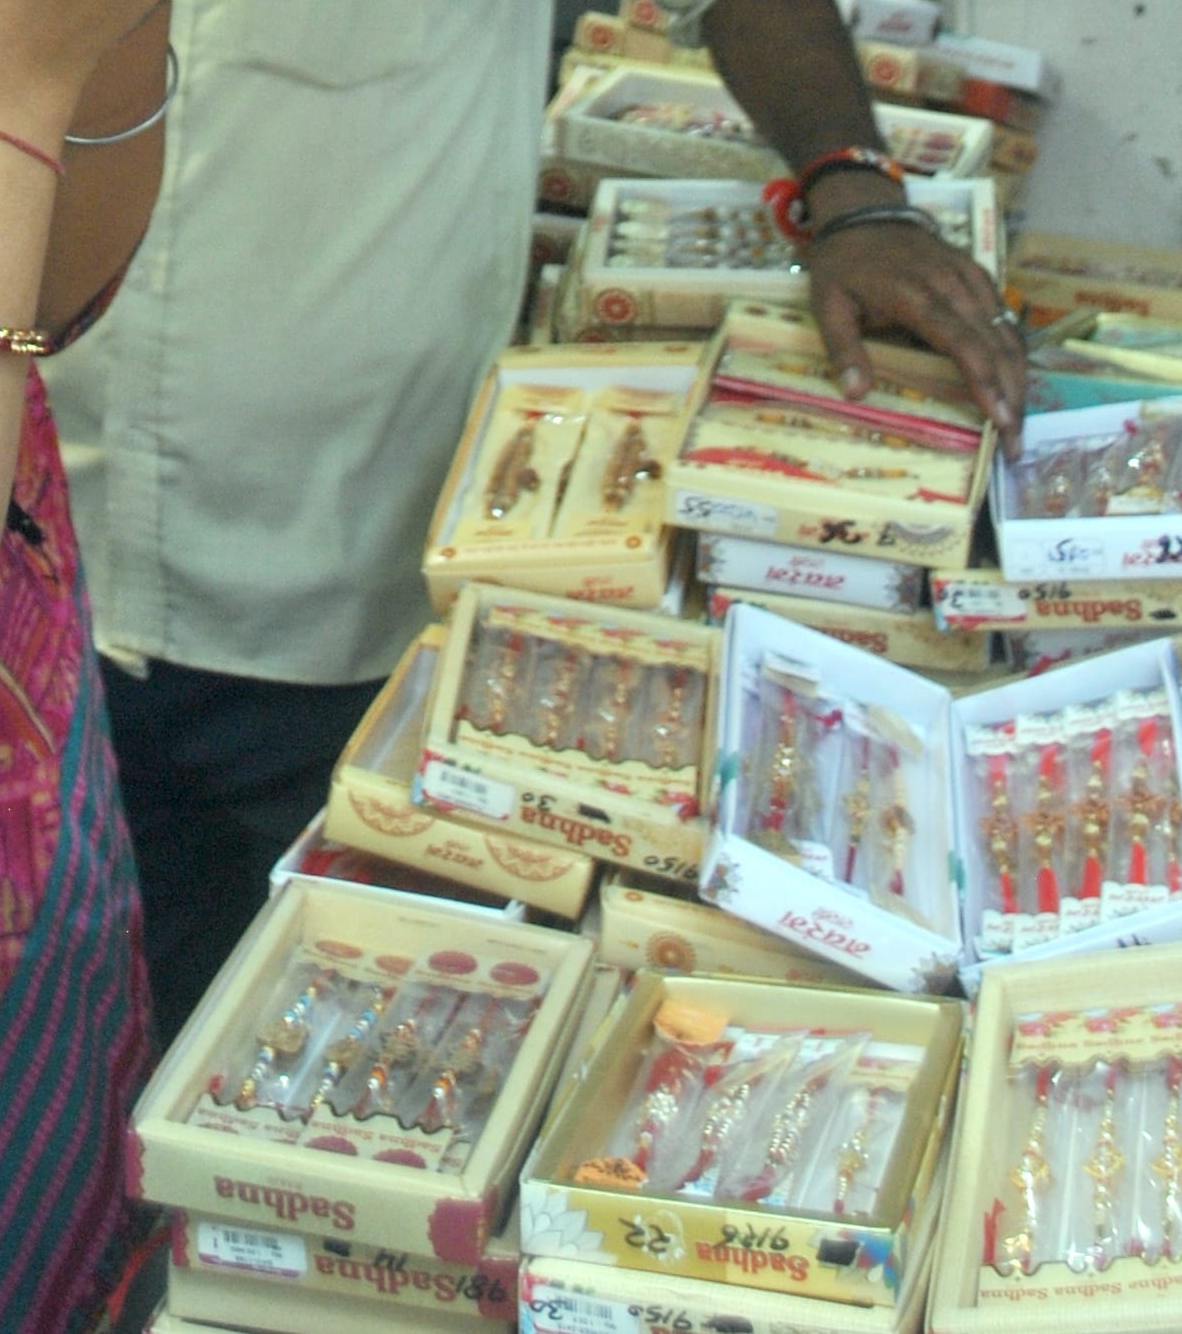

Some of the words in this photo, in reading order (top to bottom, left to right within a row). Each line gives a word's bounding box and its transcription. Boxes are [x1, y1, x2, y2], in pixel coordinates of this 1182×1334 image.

[1034, 598, 1143, 624] Sadhna
[519, 806, 633, 859] Sadhna
[779, 910, 872, 960] नवरंग
[213, 1176, 358, 1232] Sadhna
[313, 1254, 457, 1304] Sadhna
[694, 1241, 811, 1283] Sadhna
[980, 1287, 1050, 1302] Sadhna
[1054, 1281, 1122, 1298] Sadhna
